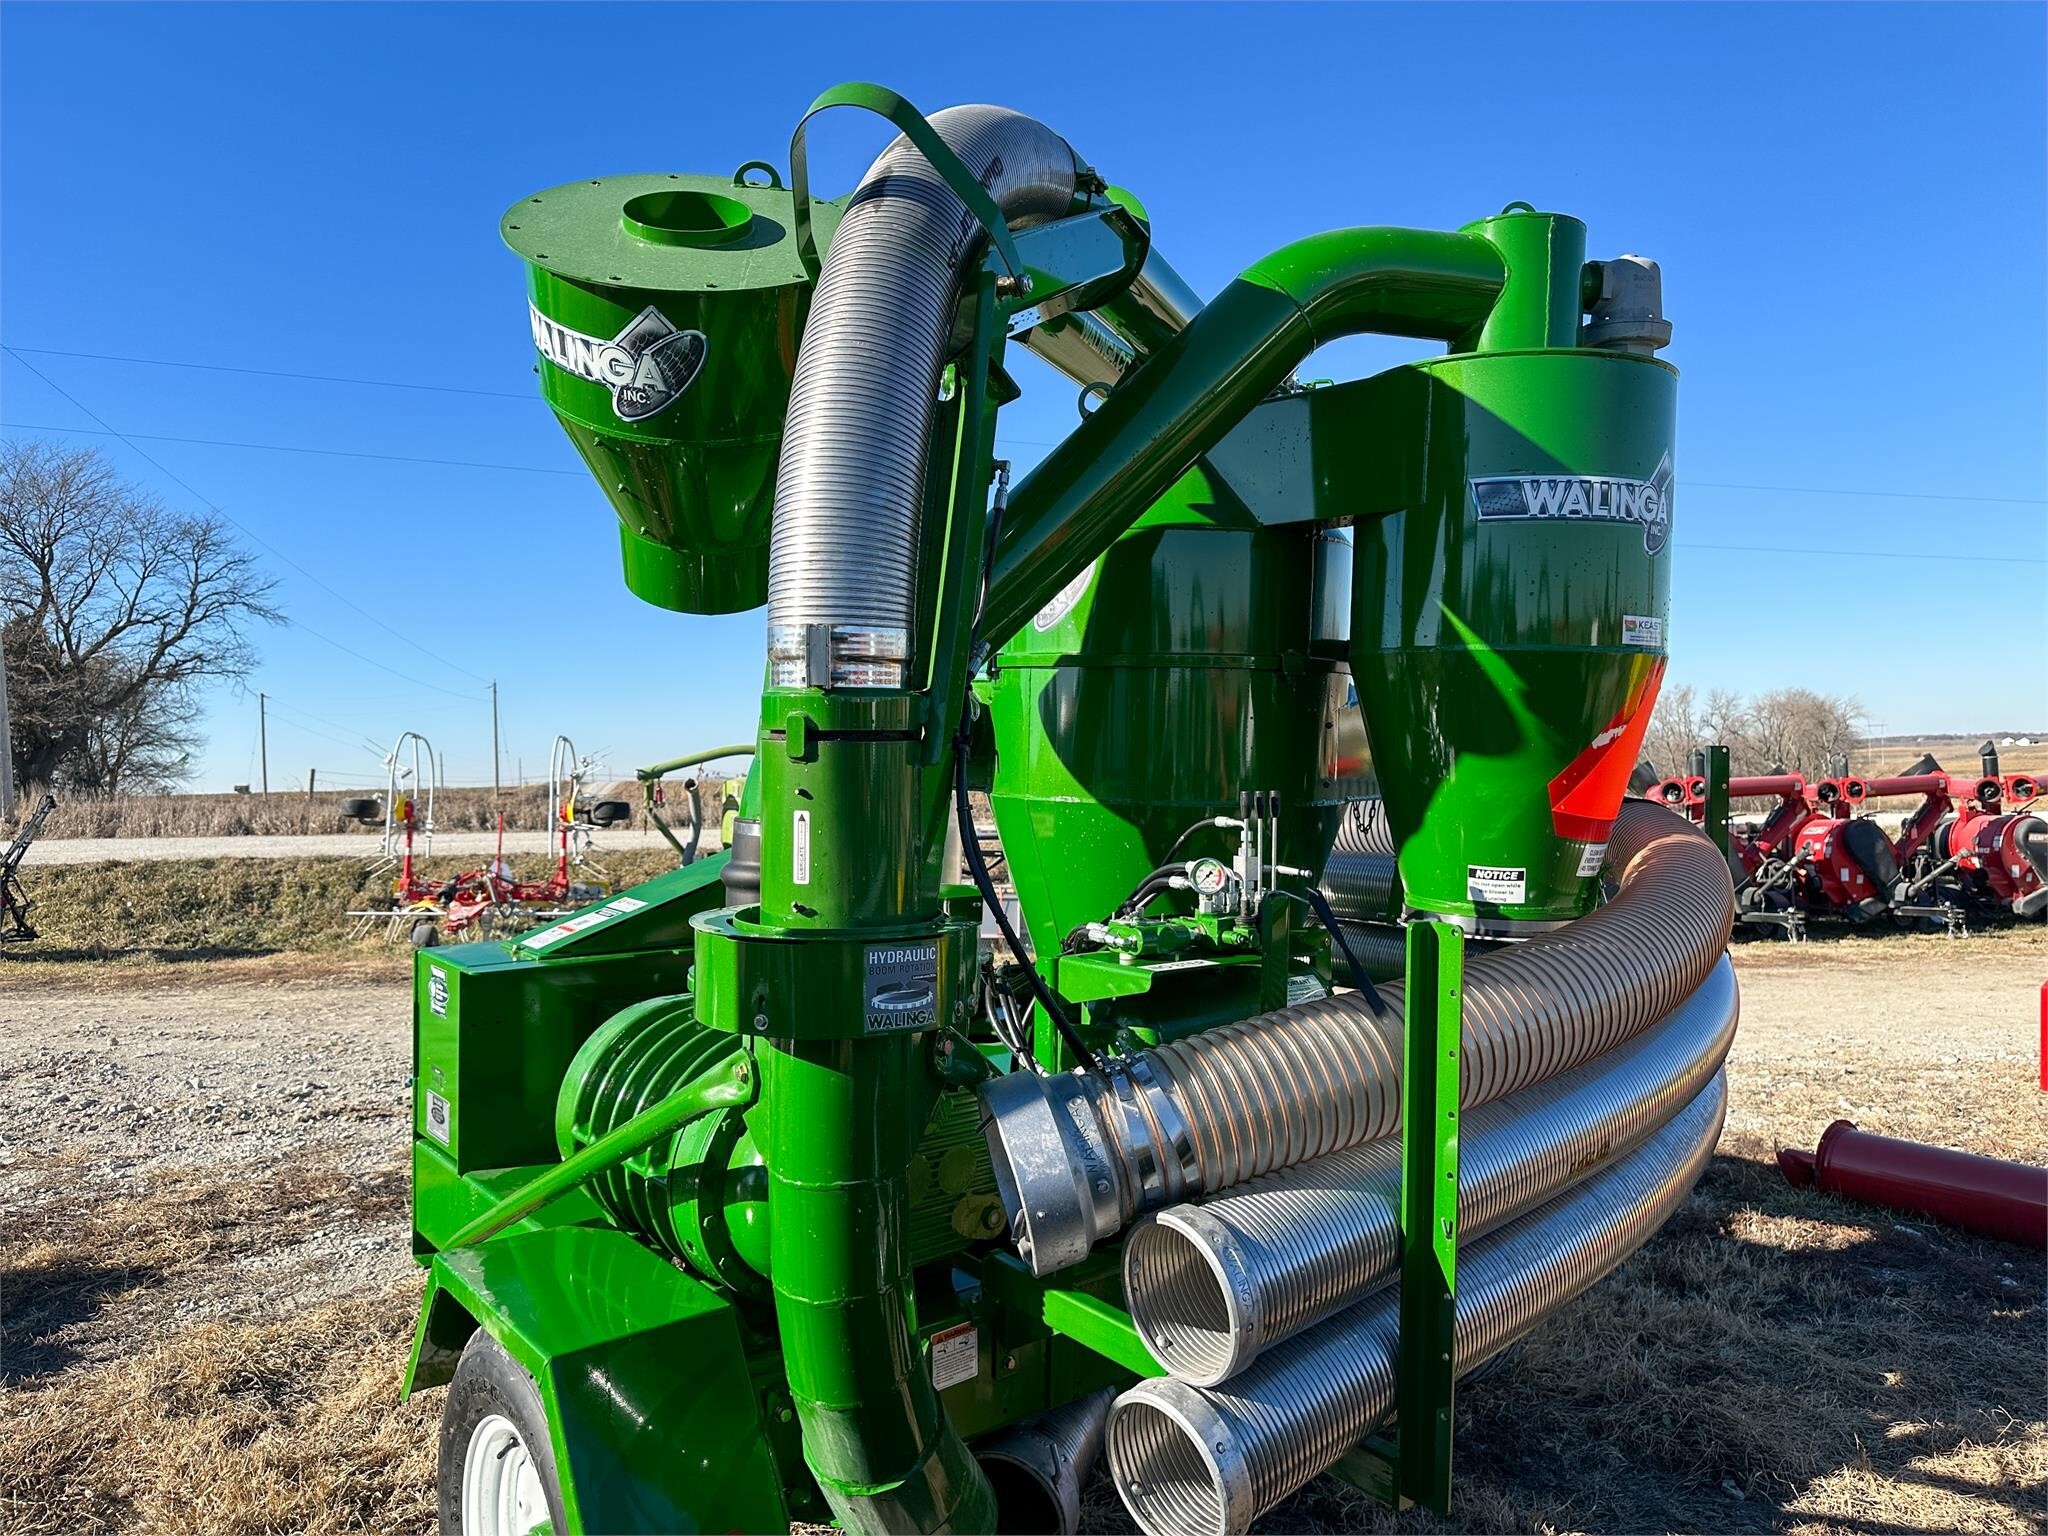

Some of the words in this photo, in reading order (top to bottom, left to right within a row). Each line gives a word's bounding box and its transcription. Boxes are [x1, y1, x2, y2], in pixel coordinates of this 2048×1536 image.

[623, 389, 651, 405] INC.
[1522, 479, 1668, 524] WALINGA
[1475, 869, 1519, 880] NOTICE
[869, 947, 936, 964] HYDRAULIC
[869, 965, 896, 976] BOOM
[900, 962, 935, 973] ROTATION
[867, 1008, 936, 1029] WALINGA
